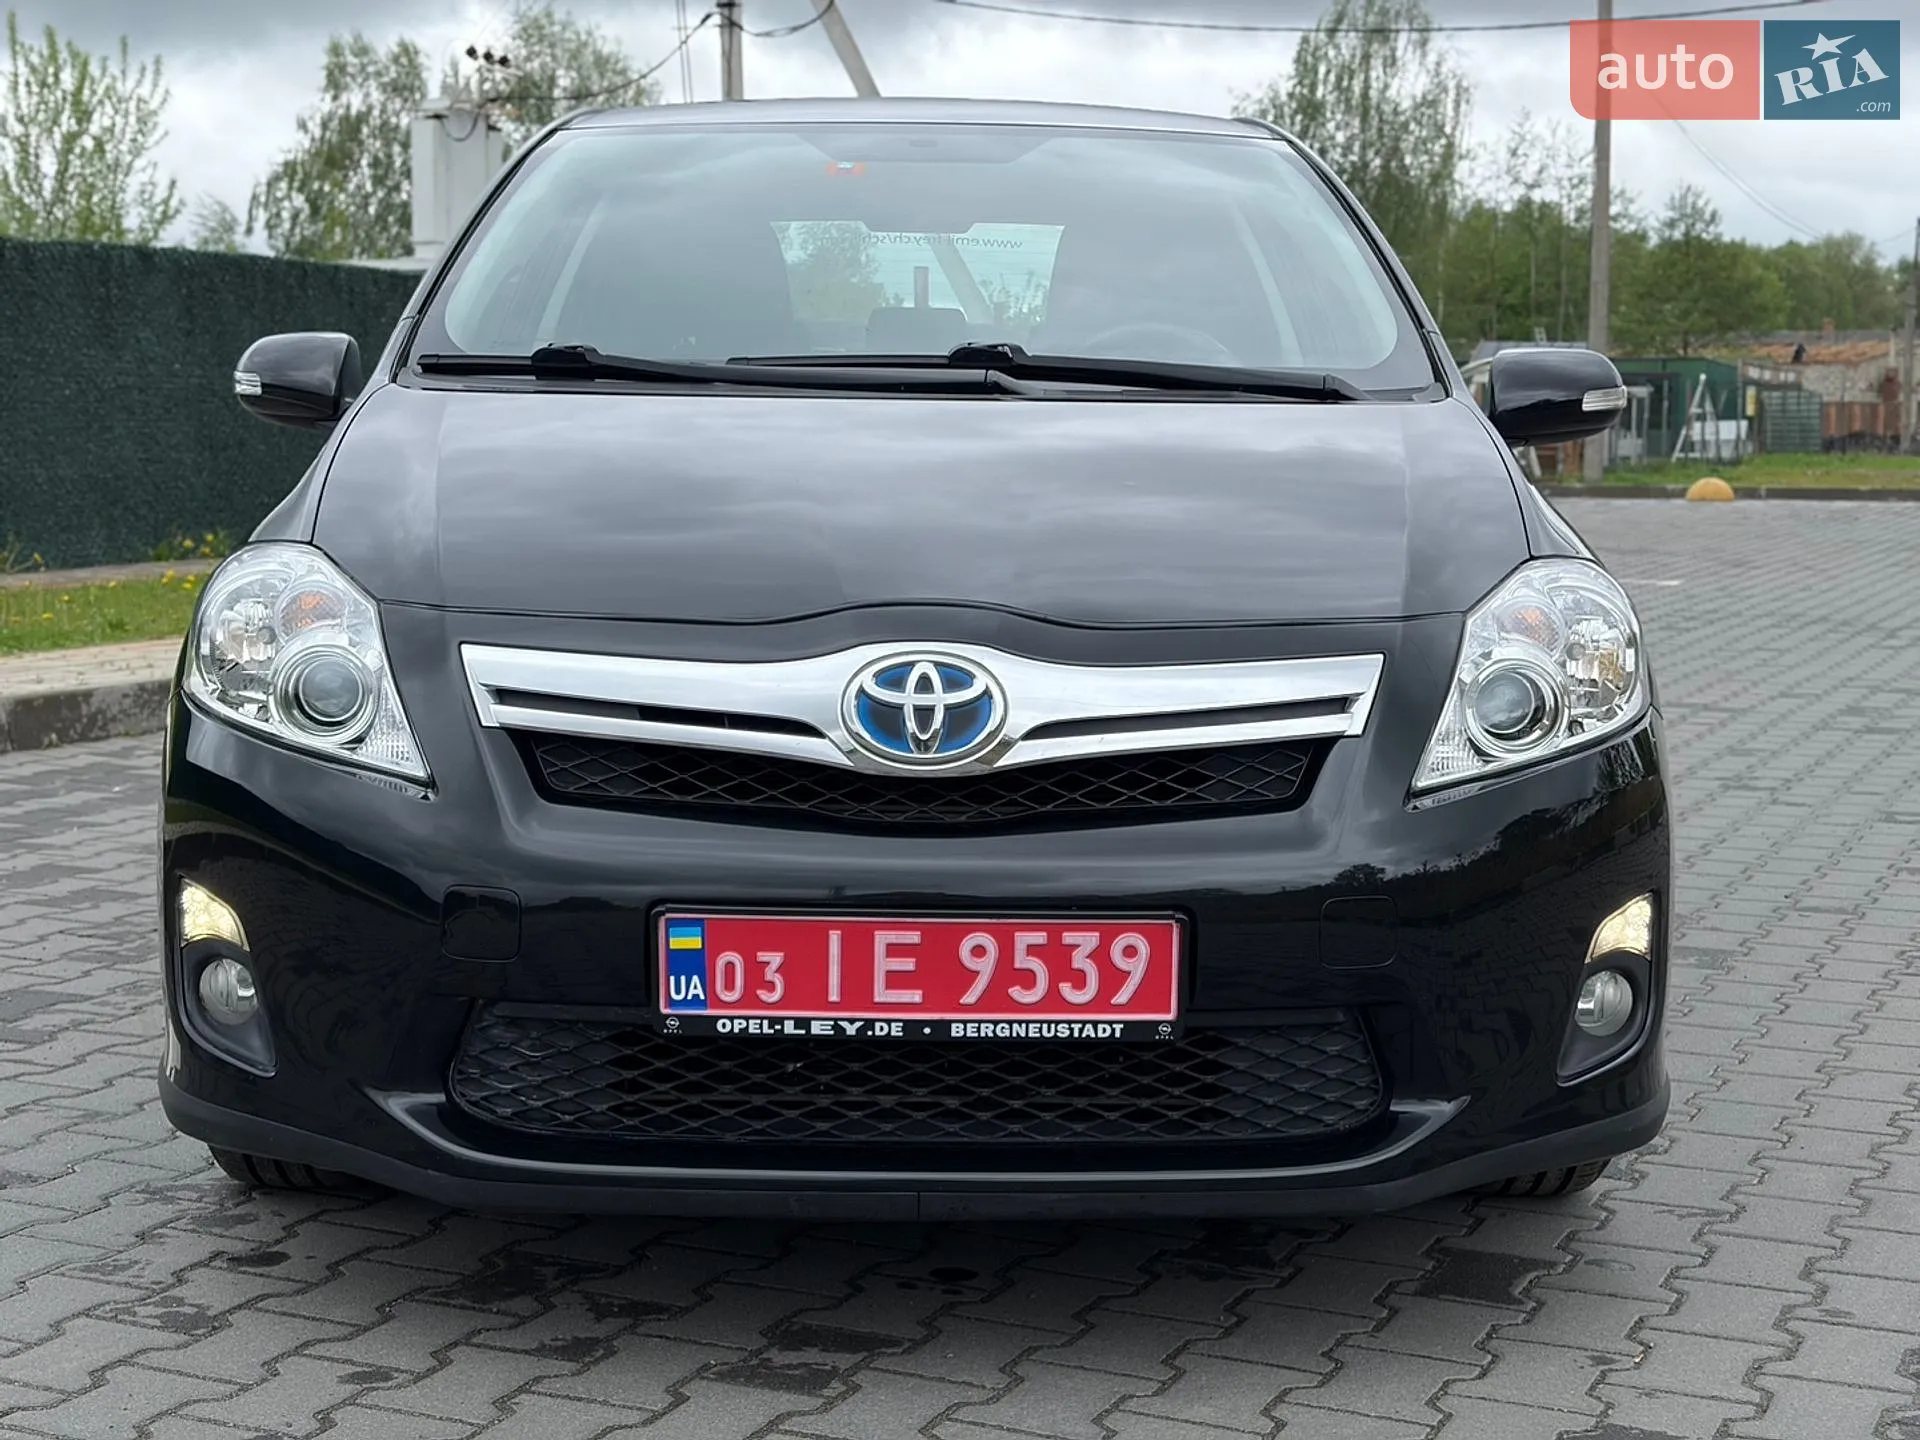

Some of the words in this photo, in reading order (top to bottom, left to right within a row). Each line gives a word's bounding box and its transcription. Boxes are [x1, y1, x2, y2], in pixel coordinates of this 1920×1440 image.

[714, 951, 785, 1004] 03
[828, 930, 923, 1004] IE
[958, 930, 1151, 1006] 9539
[669, 974, 706, 1001] UA
[715, 1018, 904, 1037] OPEL-LEY.DE
[950, 1022, 1124, 1039] BERGNEUSTADT
